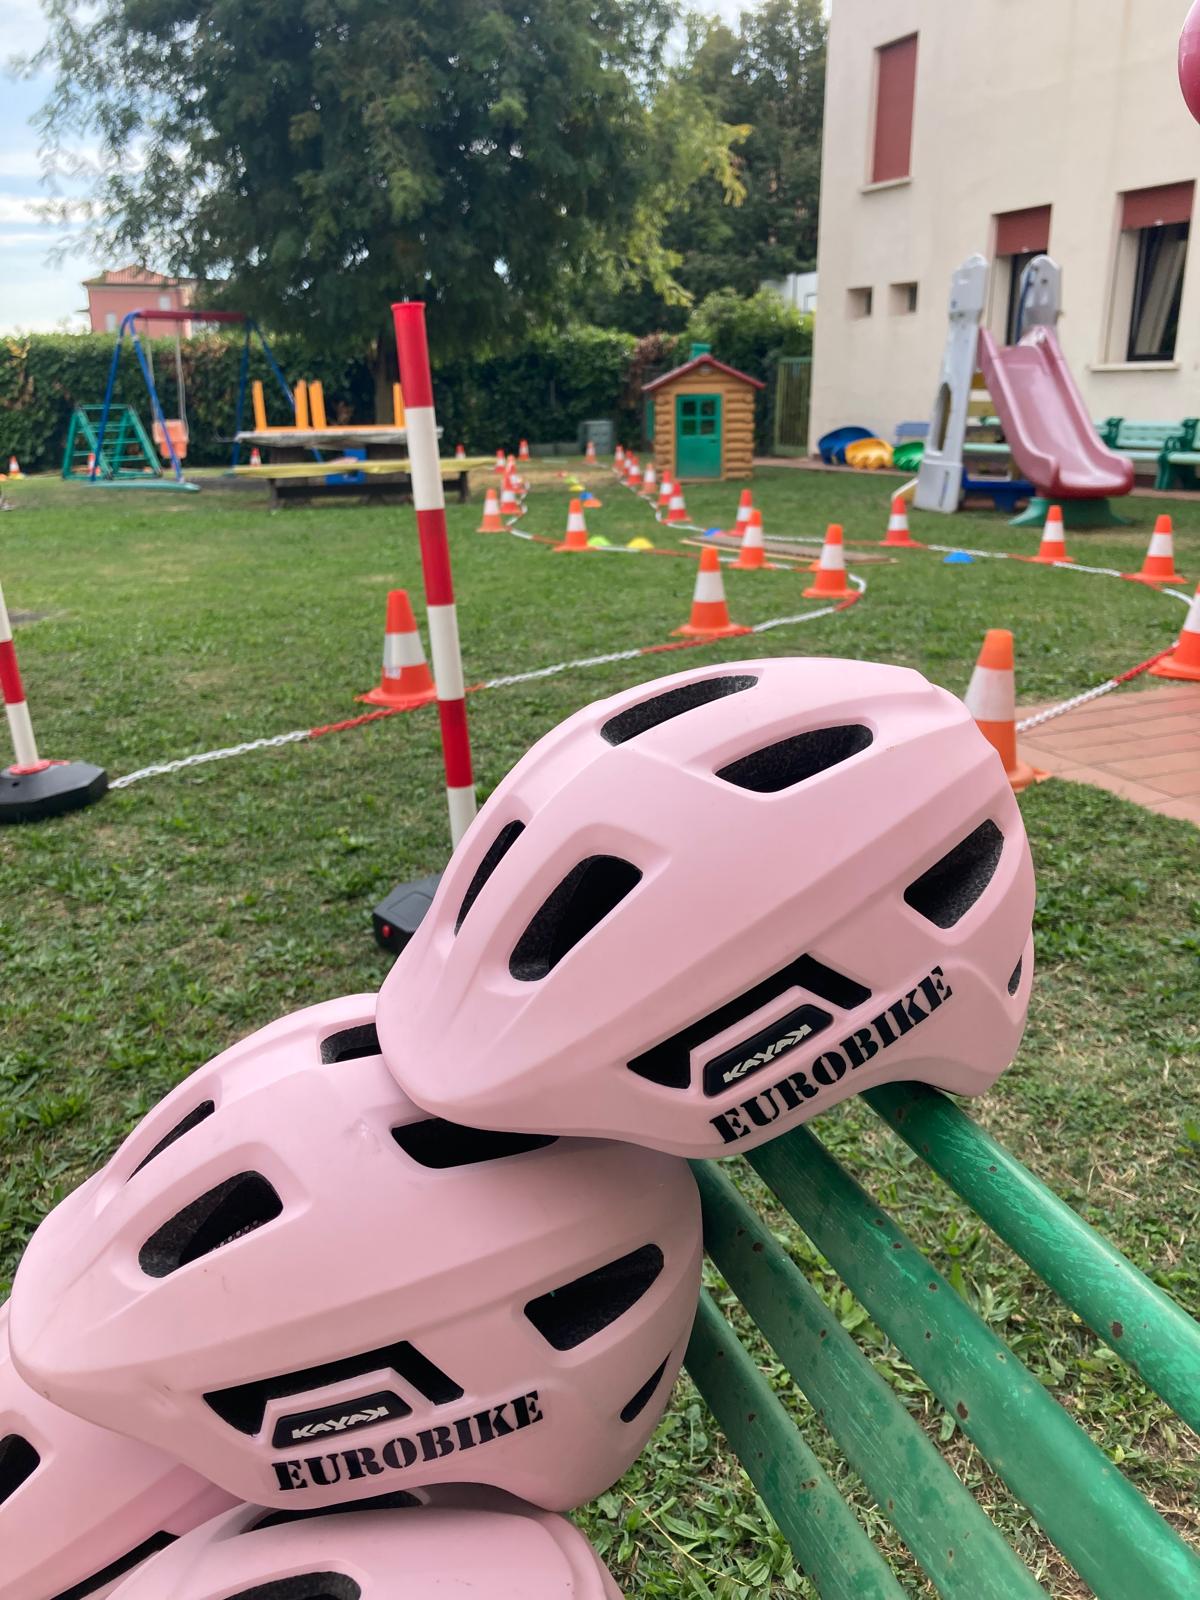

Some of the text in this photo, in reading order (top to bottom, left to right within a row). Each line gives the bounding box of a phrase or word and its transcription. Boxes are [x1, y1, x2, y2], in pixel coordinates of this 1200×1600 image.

[709, 965, 953, 1144] EUROBIKE
[722, 1024, 812, 1083] KAYAK
[271, 1390, 543, 1490] EUROBIKE
[292, 1406, 389, 1439] KAYAK
